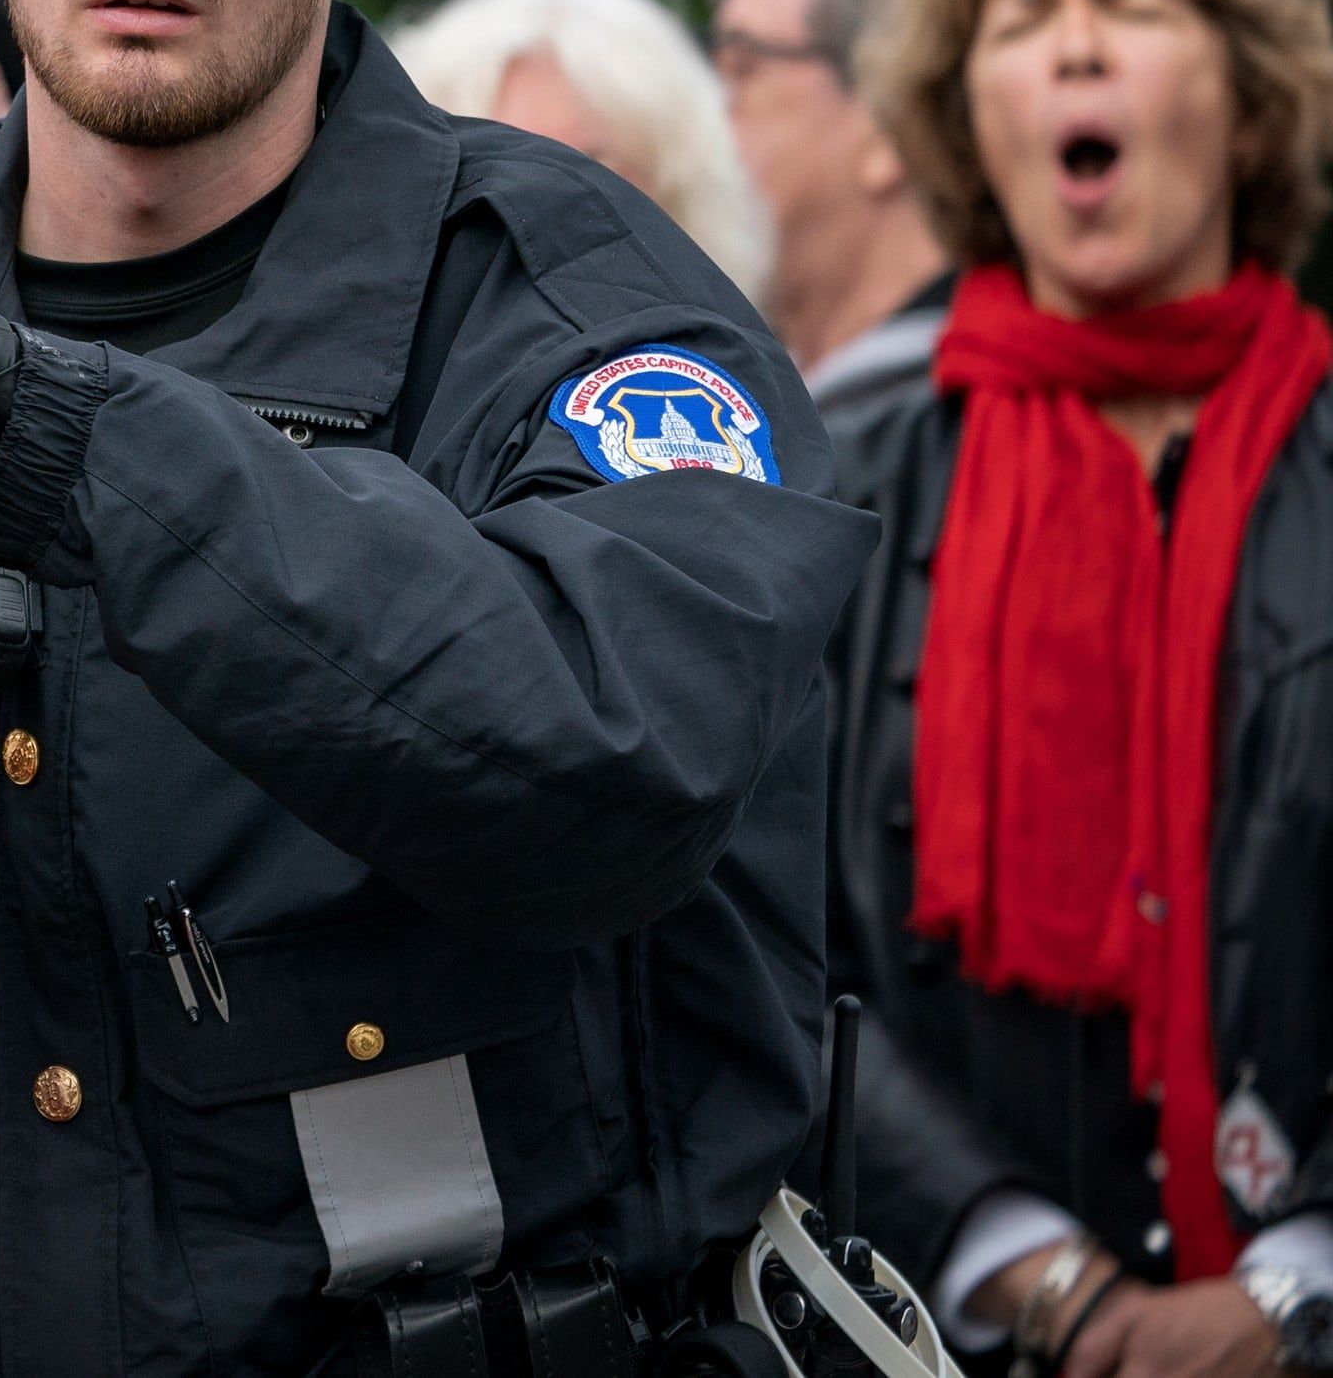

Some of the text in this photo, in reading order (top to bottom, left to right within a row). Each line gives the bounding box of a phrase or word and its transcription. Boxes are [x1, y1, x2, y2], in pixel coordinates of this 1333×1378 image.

[570, 356, 755, 421] UNITED STATES CAPITOL POLICE
